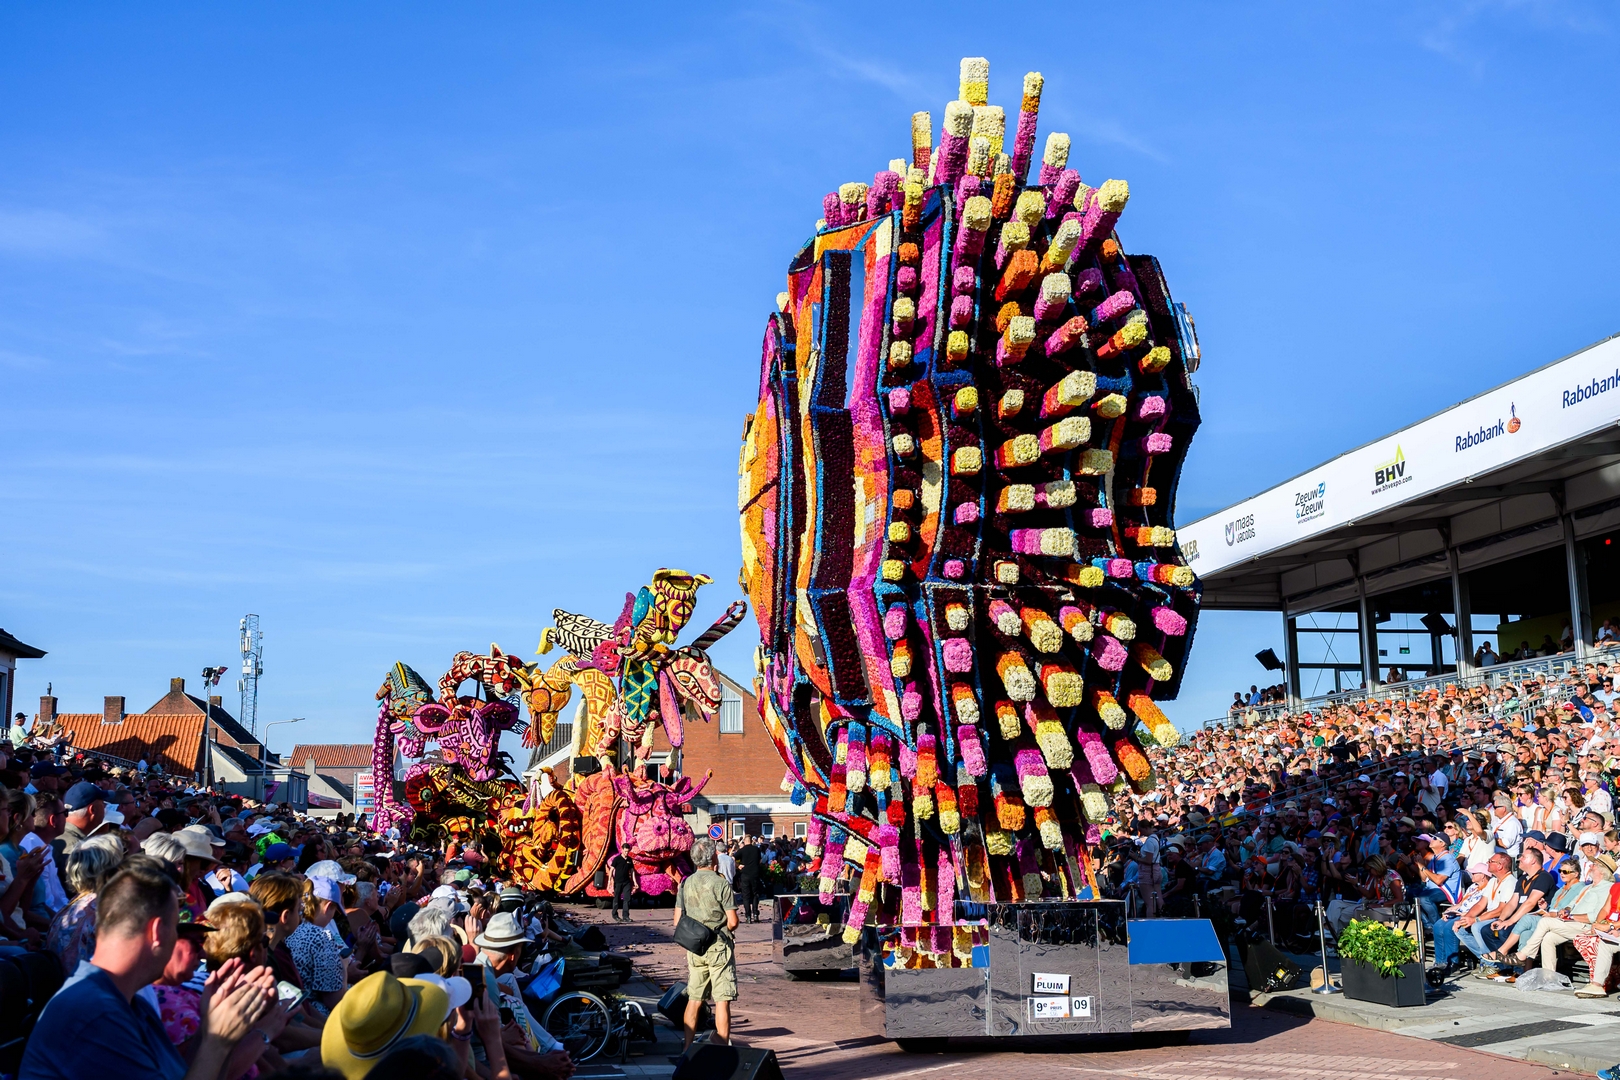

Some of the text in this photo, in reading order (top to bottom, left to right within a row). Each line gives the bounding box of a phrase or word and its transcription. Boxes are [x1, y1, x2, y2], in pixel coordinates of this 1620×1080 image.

[1562, 368, 1620, 409] Rabobank
[1455, 418, 1505, 453] Rabobank
[1375, 460, 1405, 487] BHV
[1371, 475, 1412, 495] www.bhvexpo.com
[1295, 488, 1319, 506] Zeeuw
[1296, 509, 1301, 518] &
[1300, 499, 1323, 517] Zeeuw
[1235, 513, 1254, 531] maas
[1036, 981, 1063, 990] PLUIM
[1074, 999, 1088, 1010] 09
